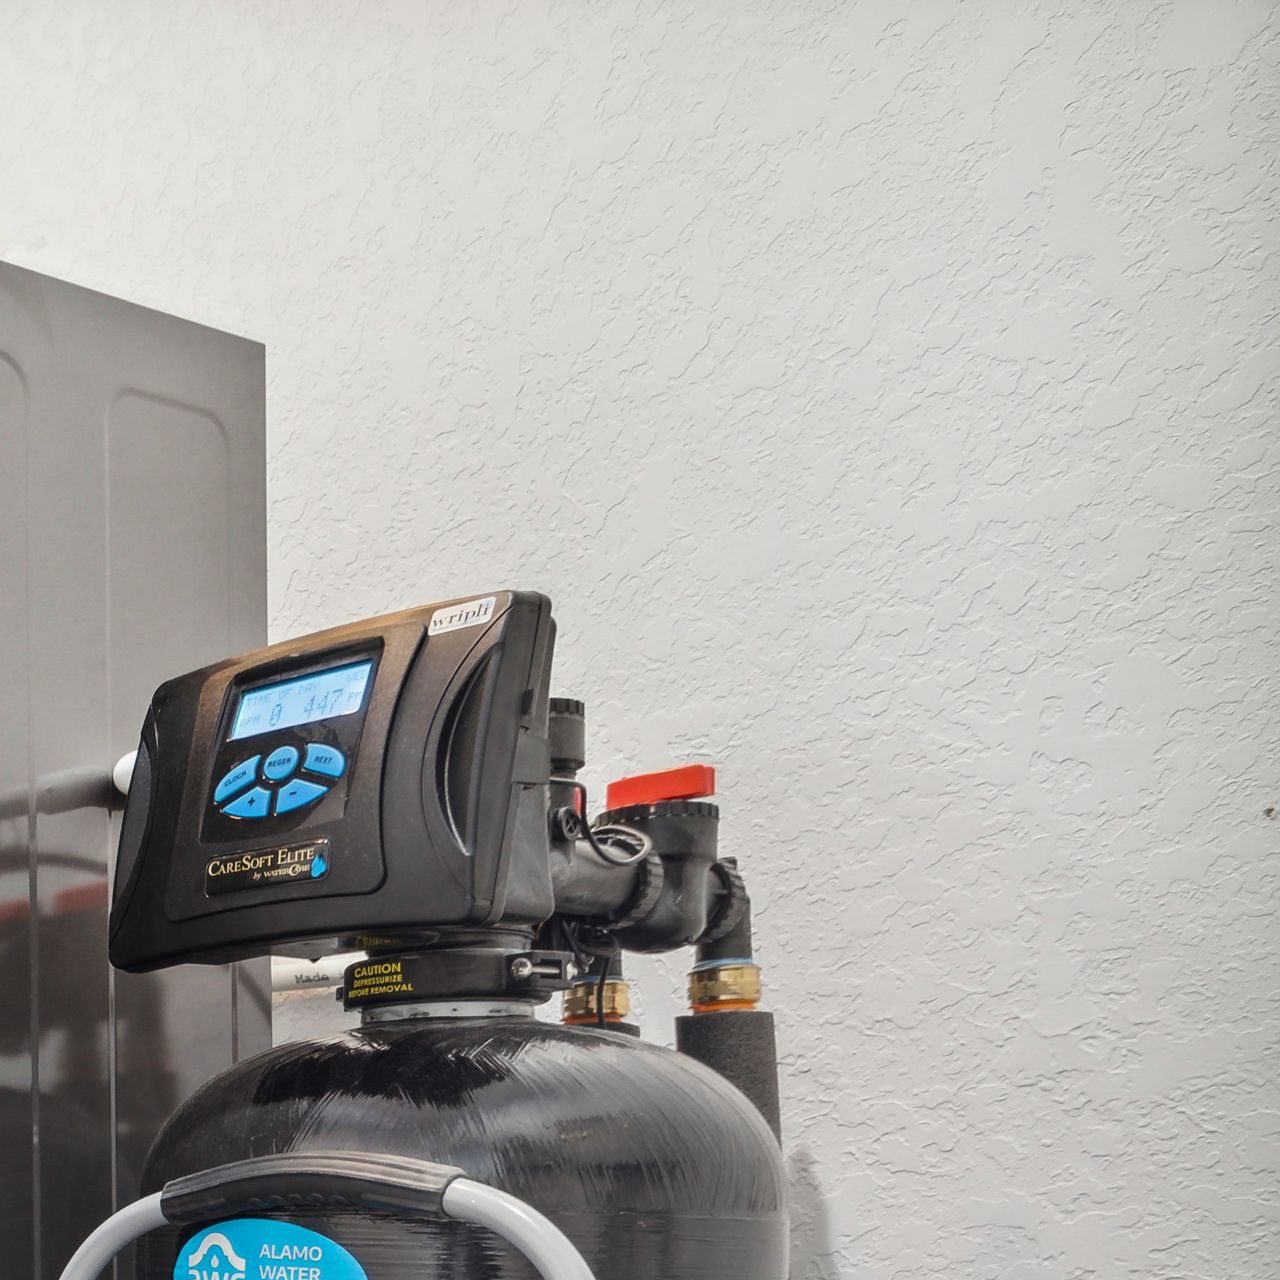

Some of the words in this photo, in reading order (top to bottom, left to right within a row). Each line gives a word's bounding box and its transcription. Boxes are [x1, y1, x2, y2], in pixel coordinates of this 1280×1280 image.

[433, 603, 491, 627] wripli
[245, 693, 272, 707] TIME
[278, 688, 294, 700] OF
[298, 681, 320, 695] DAY
[268, 757, 292, 768] REGEN
[314, 755, 333, 765] NEXT
[224, 769, 247, 787] CLOCK
[253, 872, 262, 880] by
[354, 961, 402, 978] CAUTION
[294, 972, 330, 984] Made
[353, 974, 403, 988] DEPRESSURIZE
[348, 986, 369, 999] BEFORE
[370, 983, 414, 995] REMOVAL
[259, 1244, 323, 1262] ALAMO
